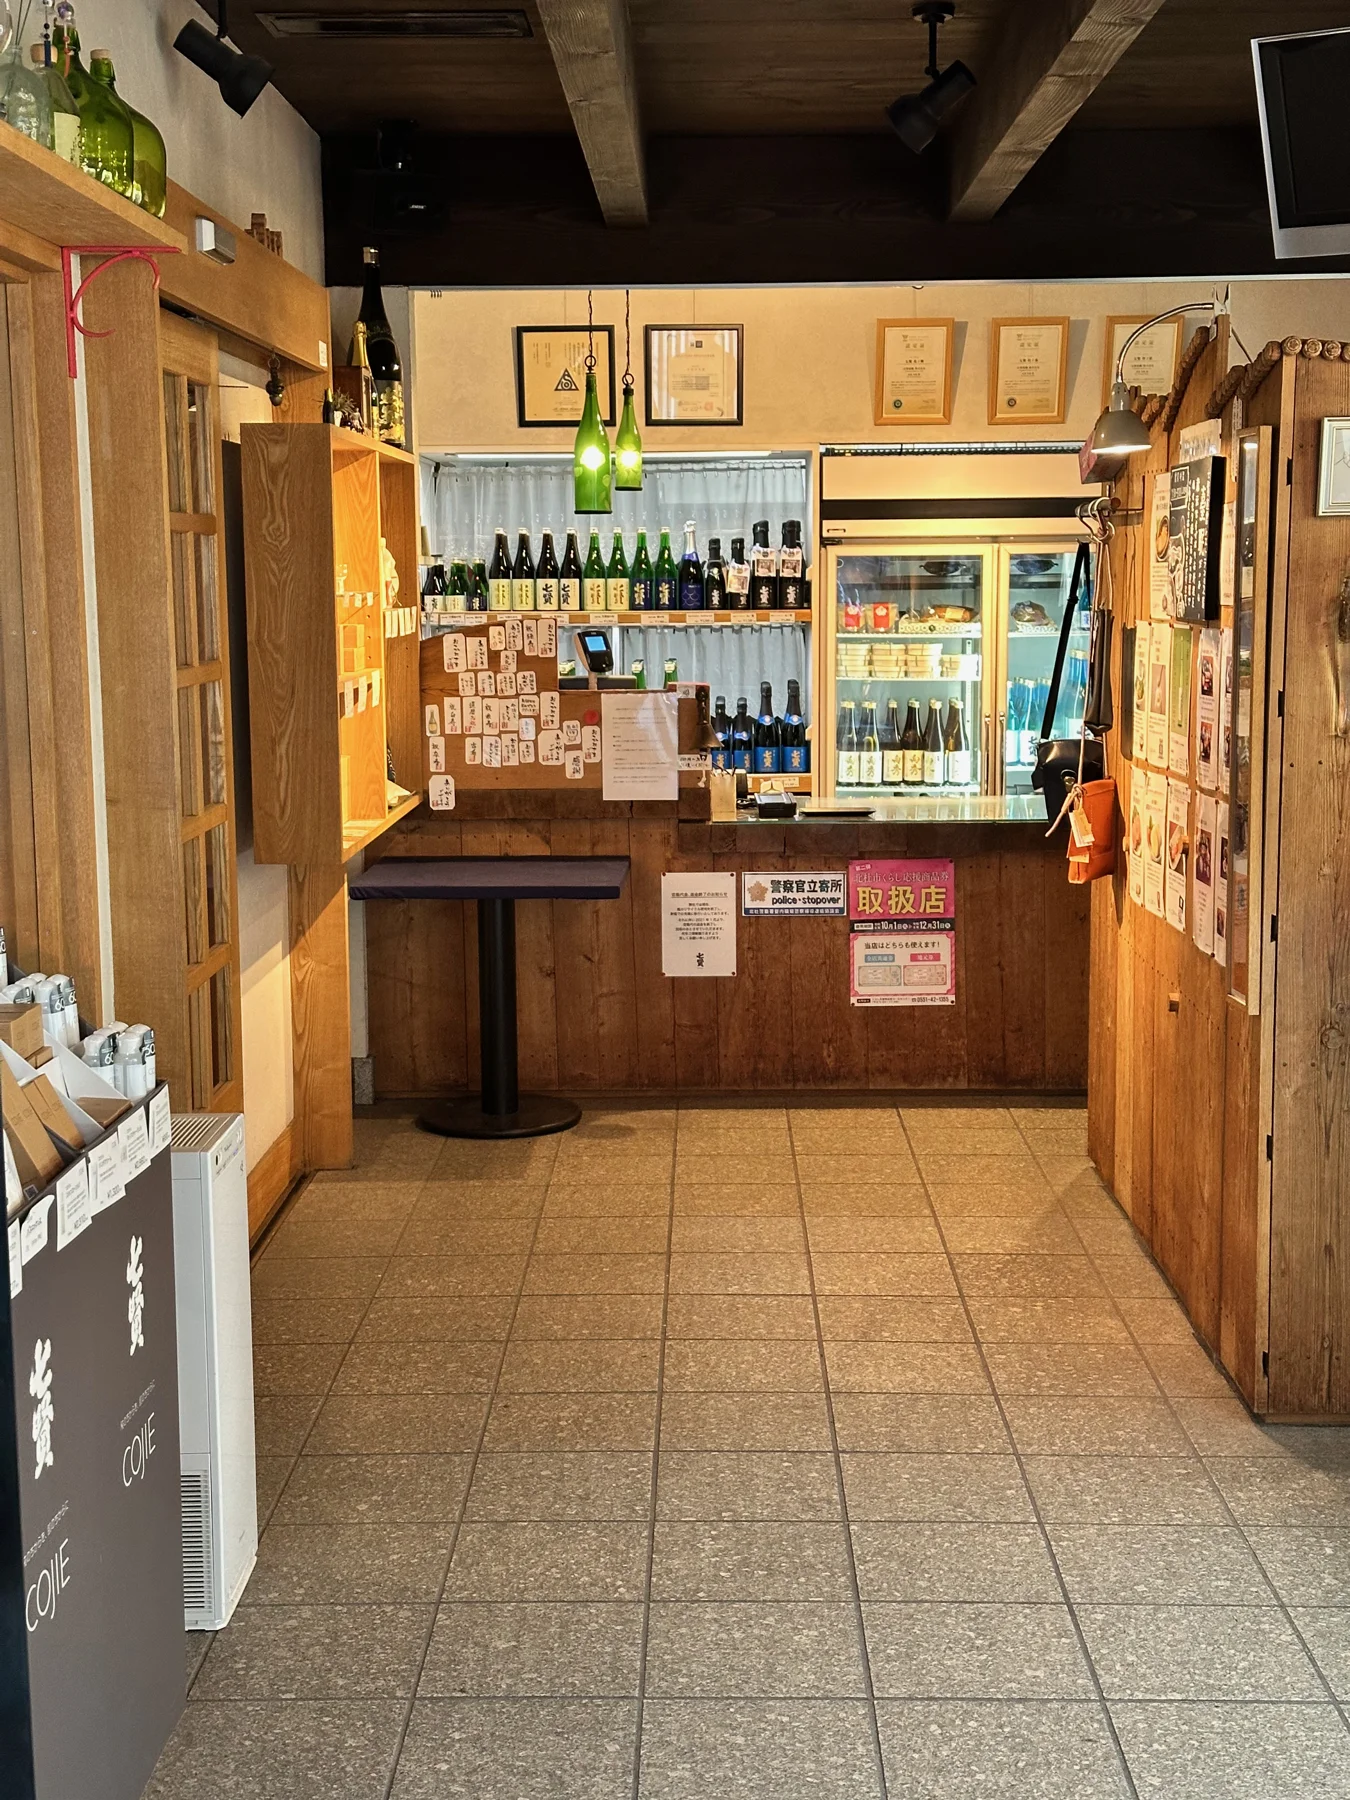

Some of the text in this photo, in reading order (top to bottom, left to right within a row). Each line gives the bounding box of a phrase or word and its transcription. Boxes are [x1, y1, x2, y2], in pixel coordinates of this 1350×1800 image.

[542, 583, 554, 605] 七賢
[561, 583, 571, 605] 七賢
[771, 879, 842, 894] 警察官立寄所
[855, 871, 949, 883] 北杜市くらし応援商品券
[856, 884, 948, 915] 取扱店
[122, 1411, 156, 1488] COJIE
[25, 1538, 71, 1633] COJIE
